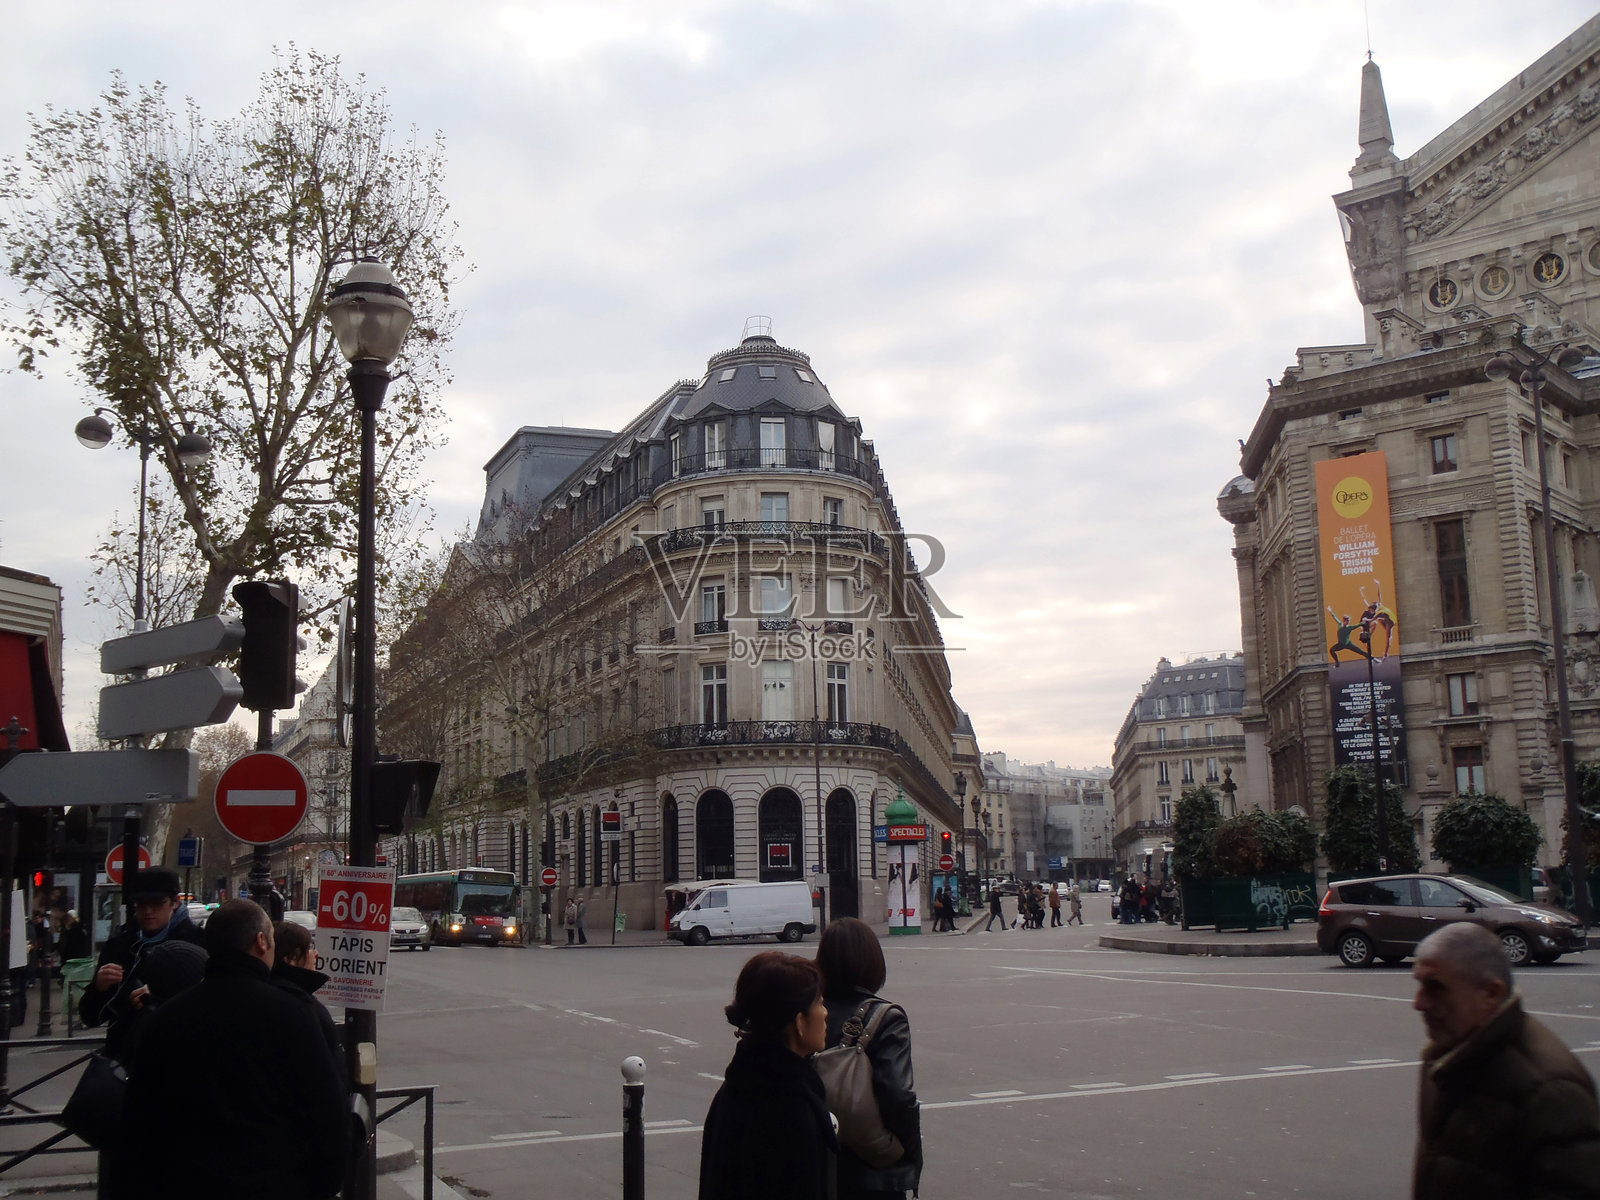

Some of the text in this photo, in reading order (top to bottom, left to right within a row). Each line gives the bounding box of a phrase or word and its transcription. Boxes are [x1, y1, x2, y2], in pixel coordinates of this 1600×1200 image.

[1340, 524, 1368, 535] BALLET
[1334, 536, 1344, 544] DE
[1339, 541, 1375, 551] WILLIAM
[1334, 548, 1380, 560] FORSYTHE
[1340, 557, 1372, 567] TRISHA
[1342, 565, 1373, 575] BROWN
[338, 870, 388, 879] ANNIVERSAIRE
[321, 890, 387, 925] -60%
[330, 936, 374, 952] TAPIS
[315, 956, 386, 975] D'ORIENT
[333, 976, 374, 986] SAVONNERIE
